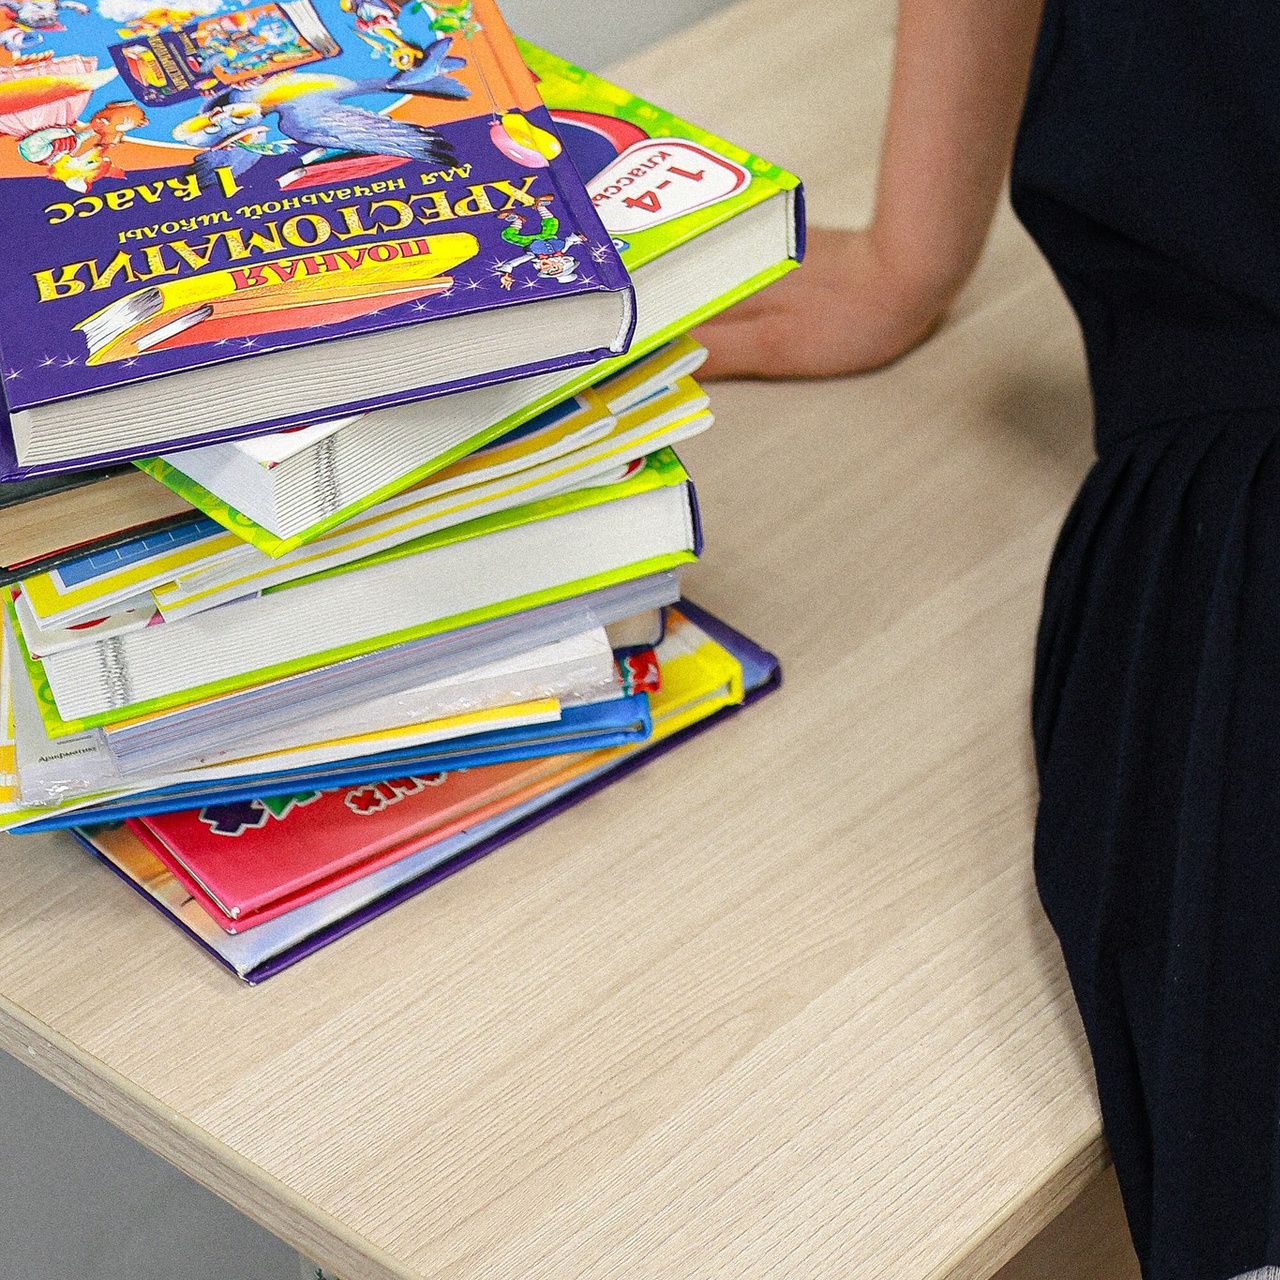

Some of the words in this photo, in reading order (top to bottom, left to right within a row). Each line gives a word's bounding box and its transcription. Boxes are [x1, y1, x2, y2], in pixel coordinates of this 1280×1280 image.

[214, 164, 244, 199] 1
[420, 162, 473, 186] для
[621, 165, 705, 214] 1-4
[44, 174, 203, 225] класс
[235, 176, 405, 220] начальной
[31, 175, 538, 303] ХРЕСТОМАТИЯ
[117, 208, 233, 244] школы
[229, 238, 431, 291] ПОЛНАЯ
